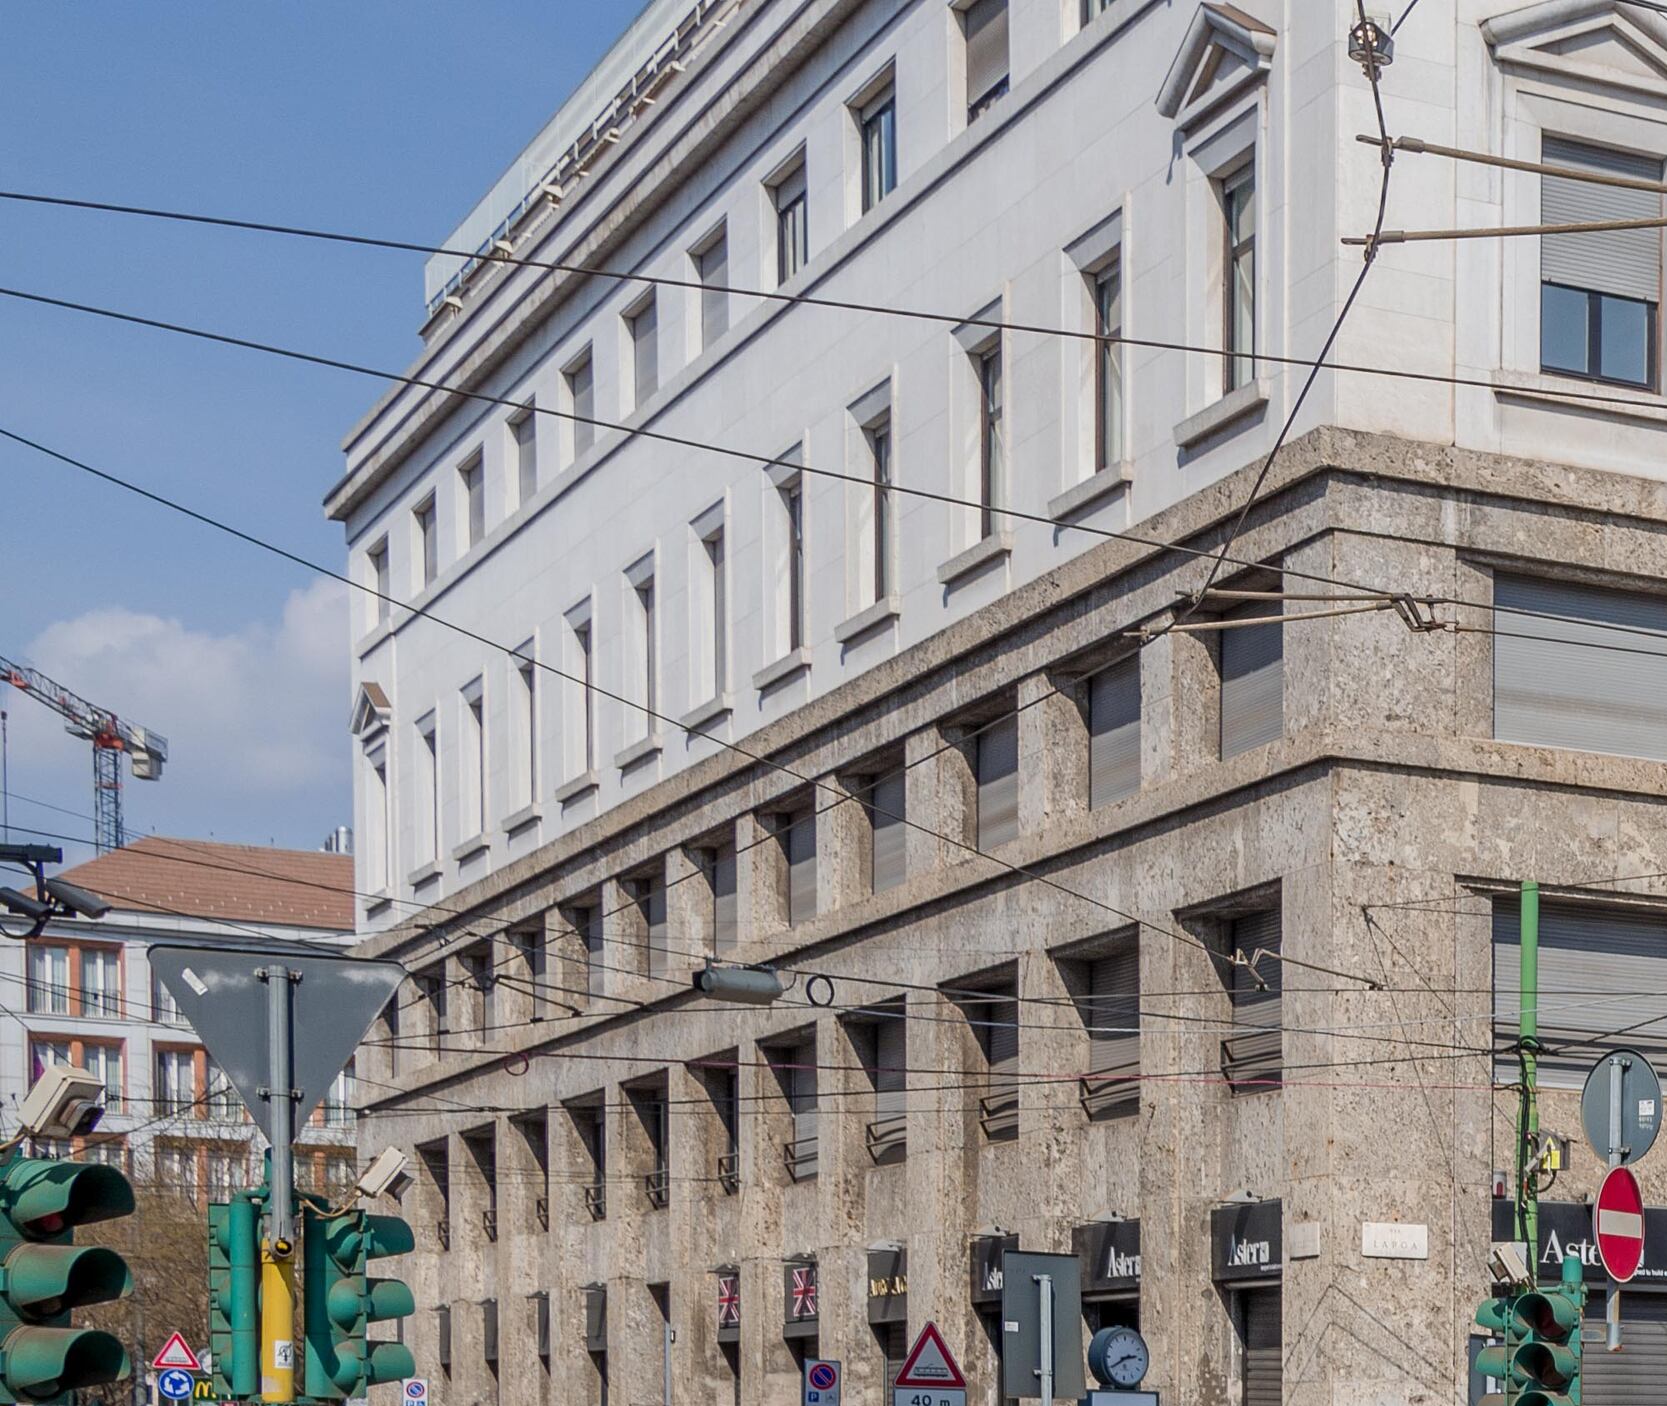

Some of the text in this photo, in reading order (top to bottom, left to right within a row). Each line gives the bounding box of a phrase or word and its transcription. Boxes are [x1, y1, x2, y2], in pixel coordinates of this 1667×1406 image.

[1227, 1233, 1260, 1267] Aster
[1540, 1229, 1602, 1267] Aste
[911, 1394, 932, 1406] 40
